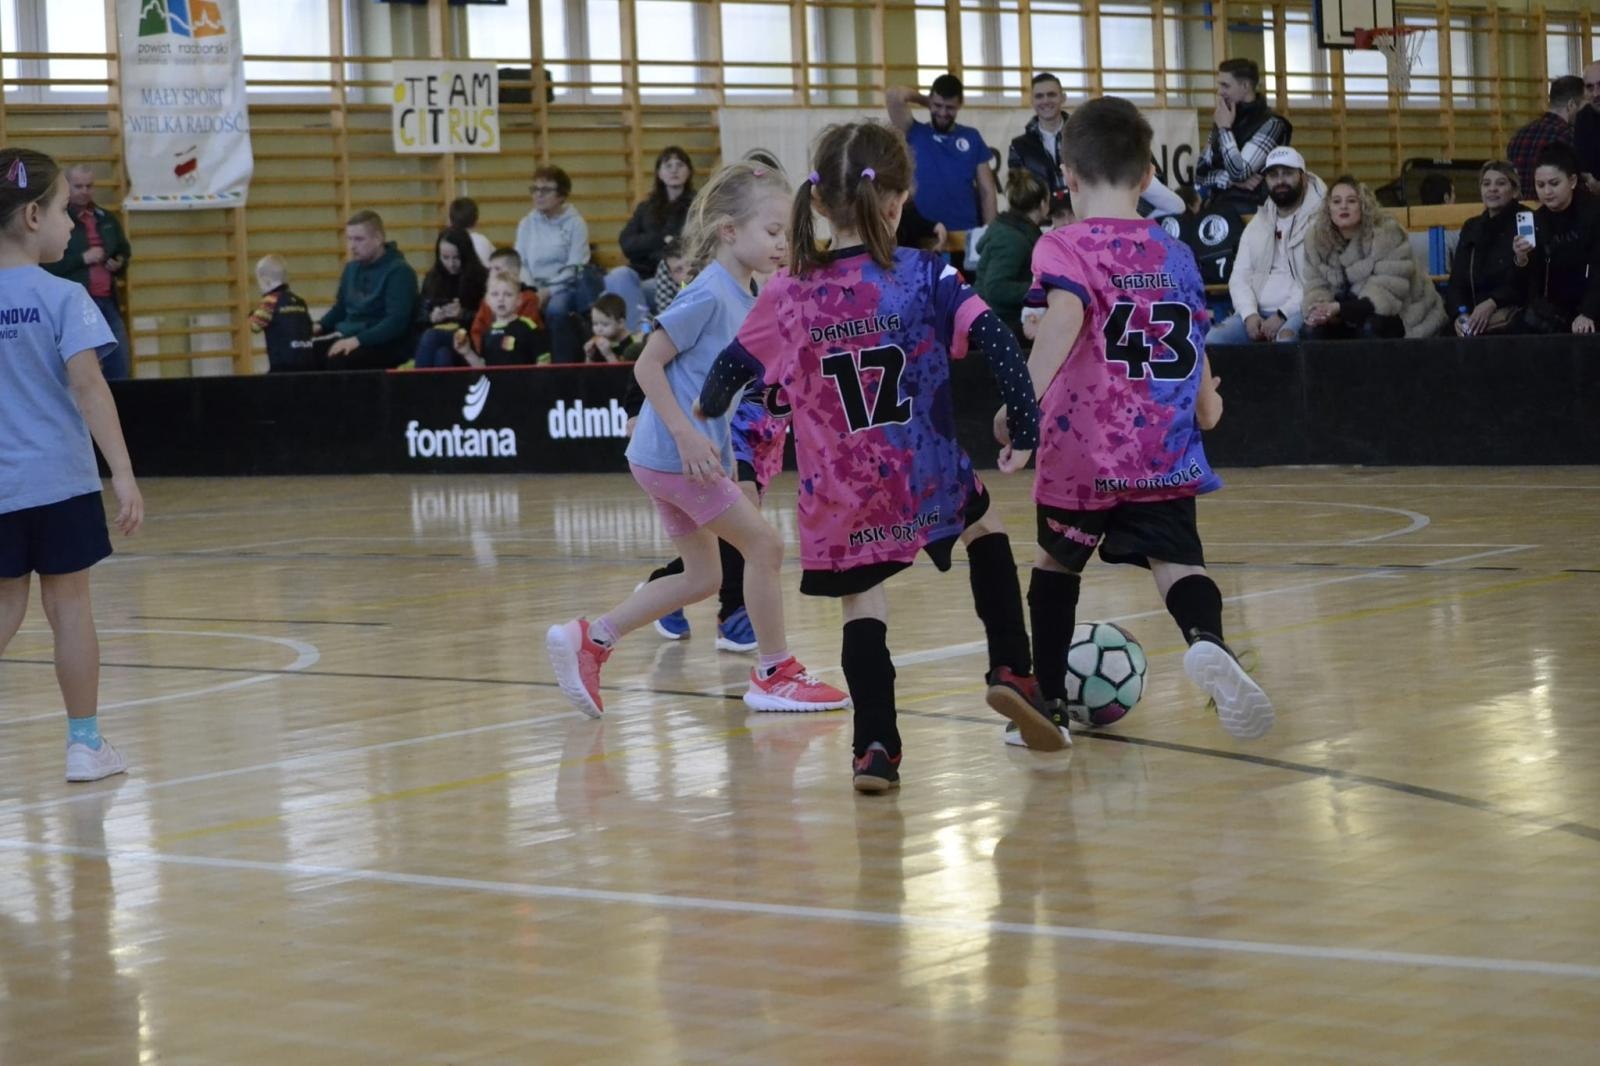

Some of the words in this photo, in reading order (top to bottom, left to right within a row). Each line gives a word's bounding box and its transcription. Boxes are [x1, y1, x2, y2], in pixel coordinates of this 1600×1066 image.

[183, 87, 224, 105] SPORT
[404, 73, 492, 106] TEAM
[128, 115, 183, 133] WIELKA
[400, 108, 496, 148] CITRUS
[1215, 257, 1227, 278] 7
[1110, 272, 1177, 290] GABRIEL
[810, 314, 901, 343] DANIELKA
[1103, 301, 1199, 382] 43
[820, 343, 913, 434] 12
[405, 420, 517, 458] fontana
[1094, 477, 1129, 493] MSK
[848, 526, 886, 548] MSK
